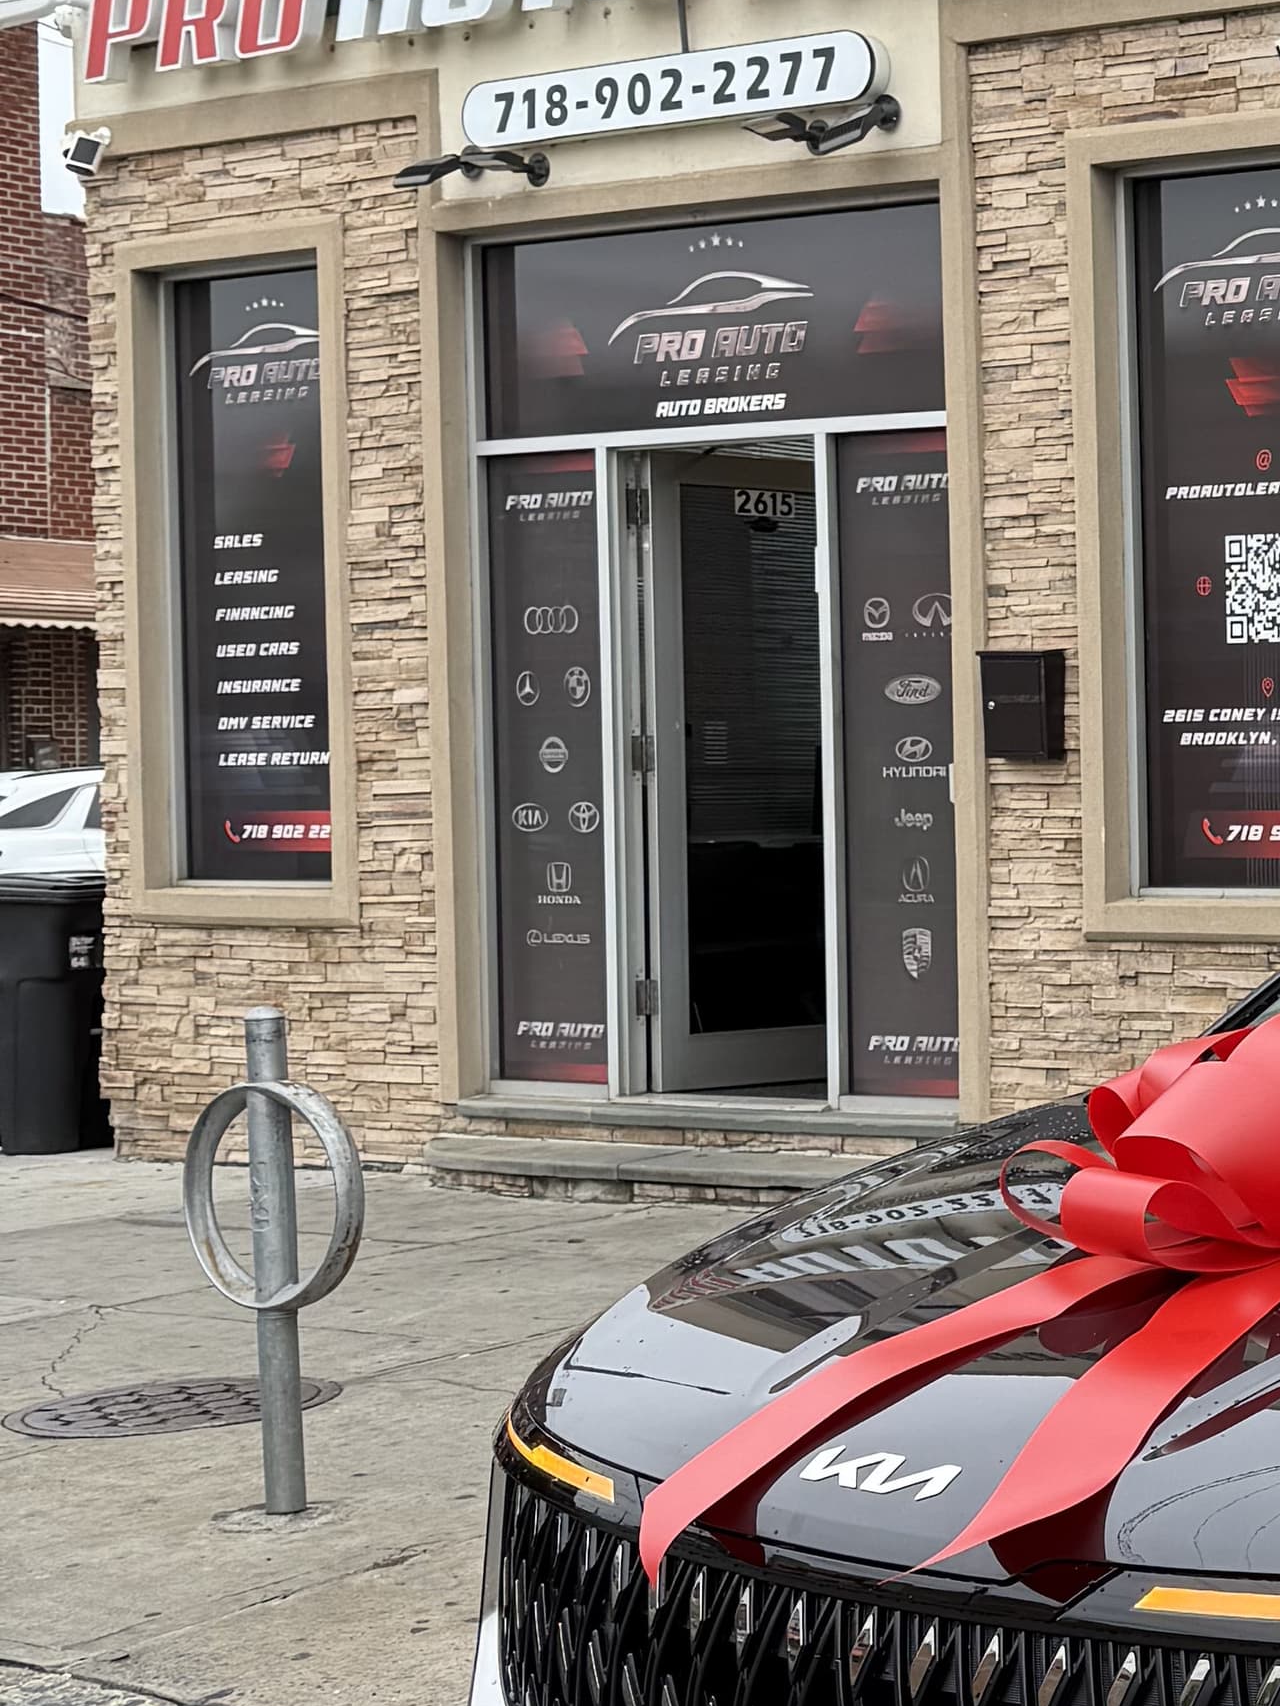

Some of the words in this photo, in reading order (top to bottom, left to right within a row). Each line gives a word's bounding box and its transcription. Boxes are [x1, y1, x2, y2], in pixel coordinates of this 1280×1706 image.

[493, 46, 837, 135] 718-902-2277
[1179, 276, 1251, 308] PRO
[633, 329, 707, 365] PRO
[711, 321, 809, 358] AUTO
[207, 363, 258, 389] PRO
[659, 362, 781, 388] LEASING
[225, 385, 309, 405] LEASING
[656, 398, 702, 418] AUTO
[703, 393, 787, 415] BROKERS
[856, 475, 899, 494] PRO
[505, 493, 543, 511] PRO
[544, 490, 594, 509] AUTO
[737, 490, 793, 516] 2615
[213, 533, 264, 549] SALES
[214, 569, 280, 586] LEASING
[215, 605, 296, 622] FINANCING
[216, 643, 257, 658] USED
[258, 642, 301, 656] CARS
[216, 678, 302, 694] INSURANCE
[217, 716, 249, 730] DMV
[250, 715, 316, 729] SERVICE
[1162, 708, 1205, 723] 2615
[1208, 707, 1266, 722] CONEY
[1180, 731, 1276, 746] BROOKLYN,
[218, 752, 268, 767] LEASE
[270, 751, 330, 765] RETURN
[882, 766, 947, 778] HYUNDAI
[518, 809, 543, 825] KIA
[242, 824, 269, 839] 718
[271, 824, 305, 839] 902
[1226, 825, 1264, 841] 718
[538, 895, 582, 905] HONDA
[898, 893, 935, 904] ACURA
[543, 933, 591, 944] LEXUS
[516, 1021, 554, 1036] PRO
[556, 1022, 605, 1039] AUTO
[868, 1035, 910, 1052] PRO
